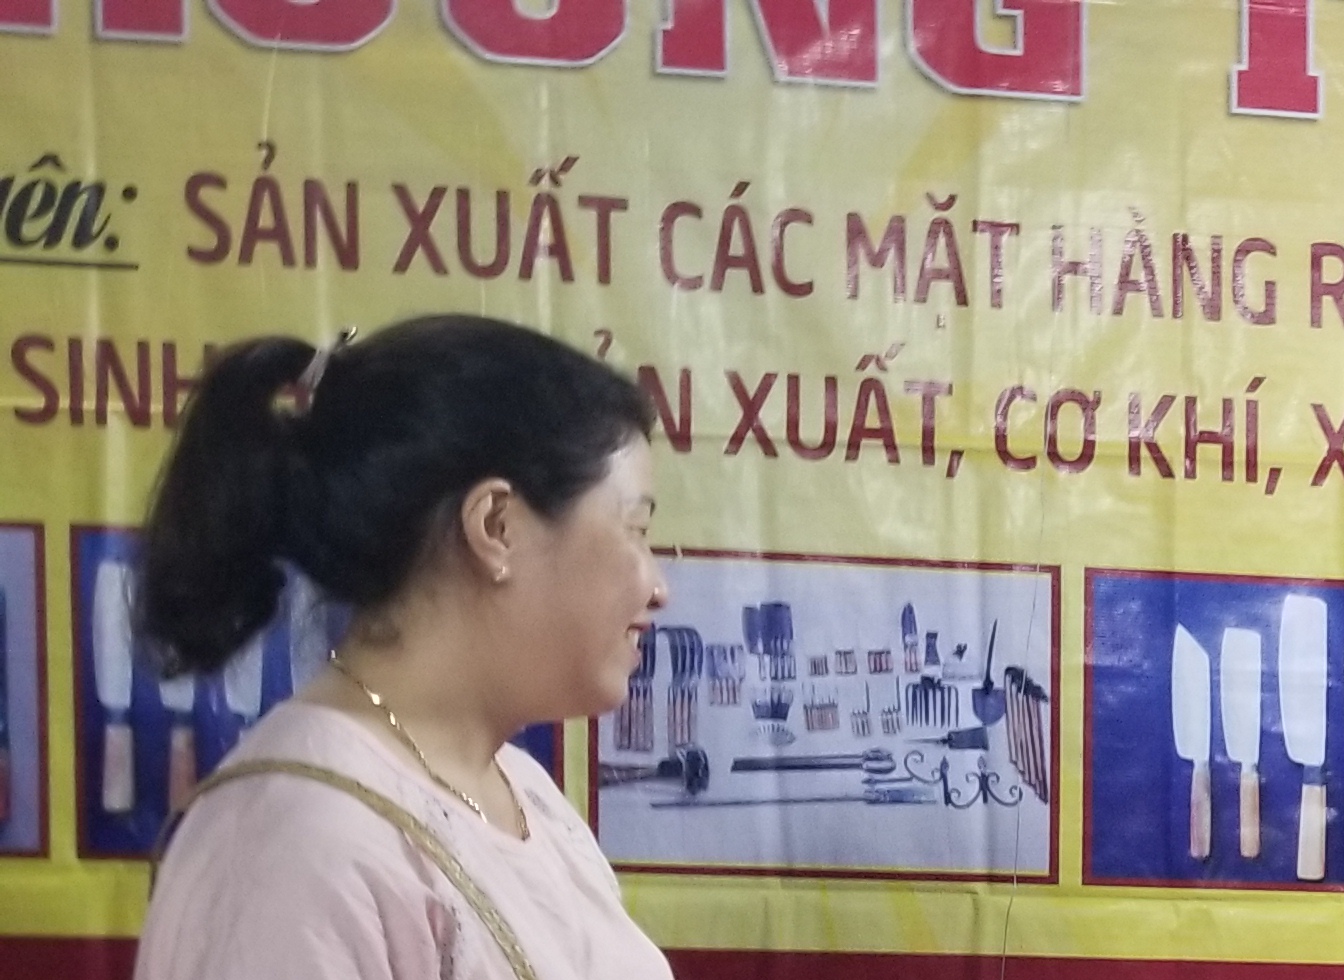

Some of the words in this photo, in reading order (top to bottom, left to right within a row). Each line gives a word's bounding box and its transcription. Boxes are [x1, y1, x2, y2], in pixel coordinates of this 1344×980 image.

[184, 142, 361, 273] SẢN
[391, 155, 628, 286] XUẤT
[658, 181, 815, 299] CÁC
[846, 193, 1020, 330] MẶT
[1050, 206, 1279, 327] HÀNG
[723, 341, 963, 478] XUẤT,
[991, 384, 1103, 475] CƠ
[1127, 376, 1283, 496] KHÍ,
